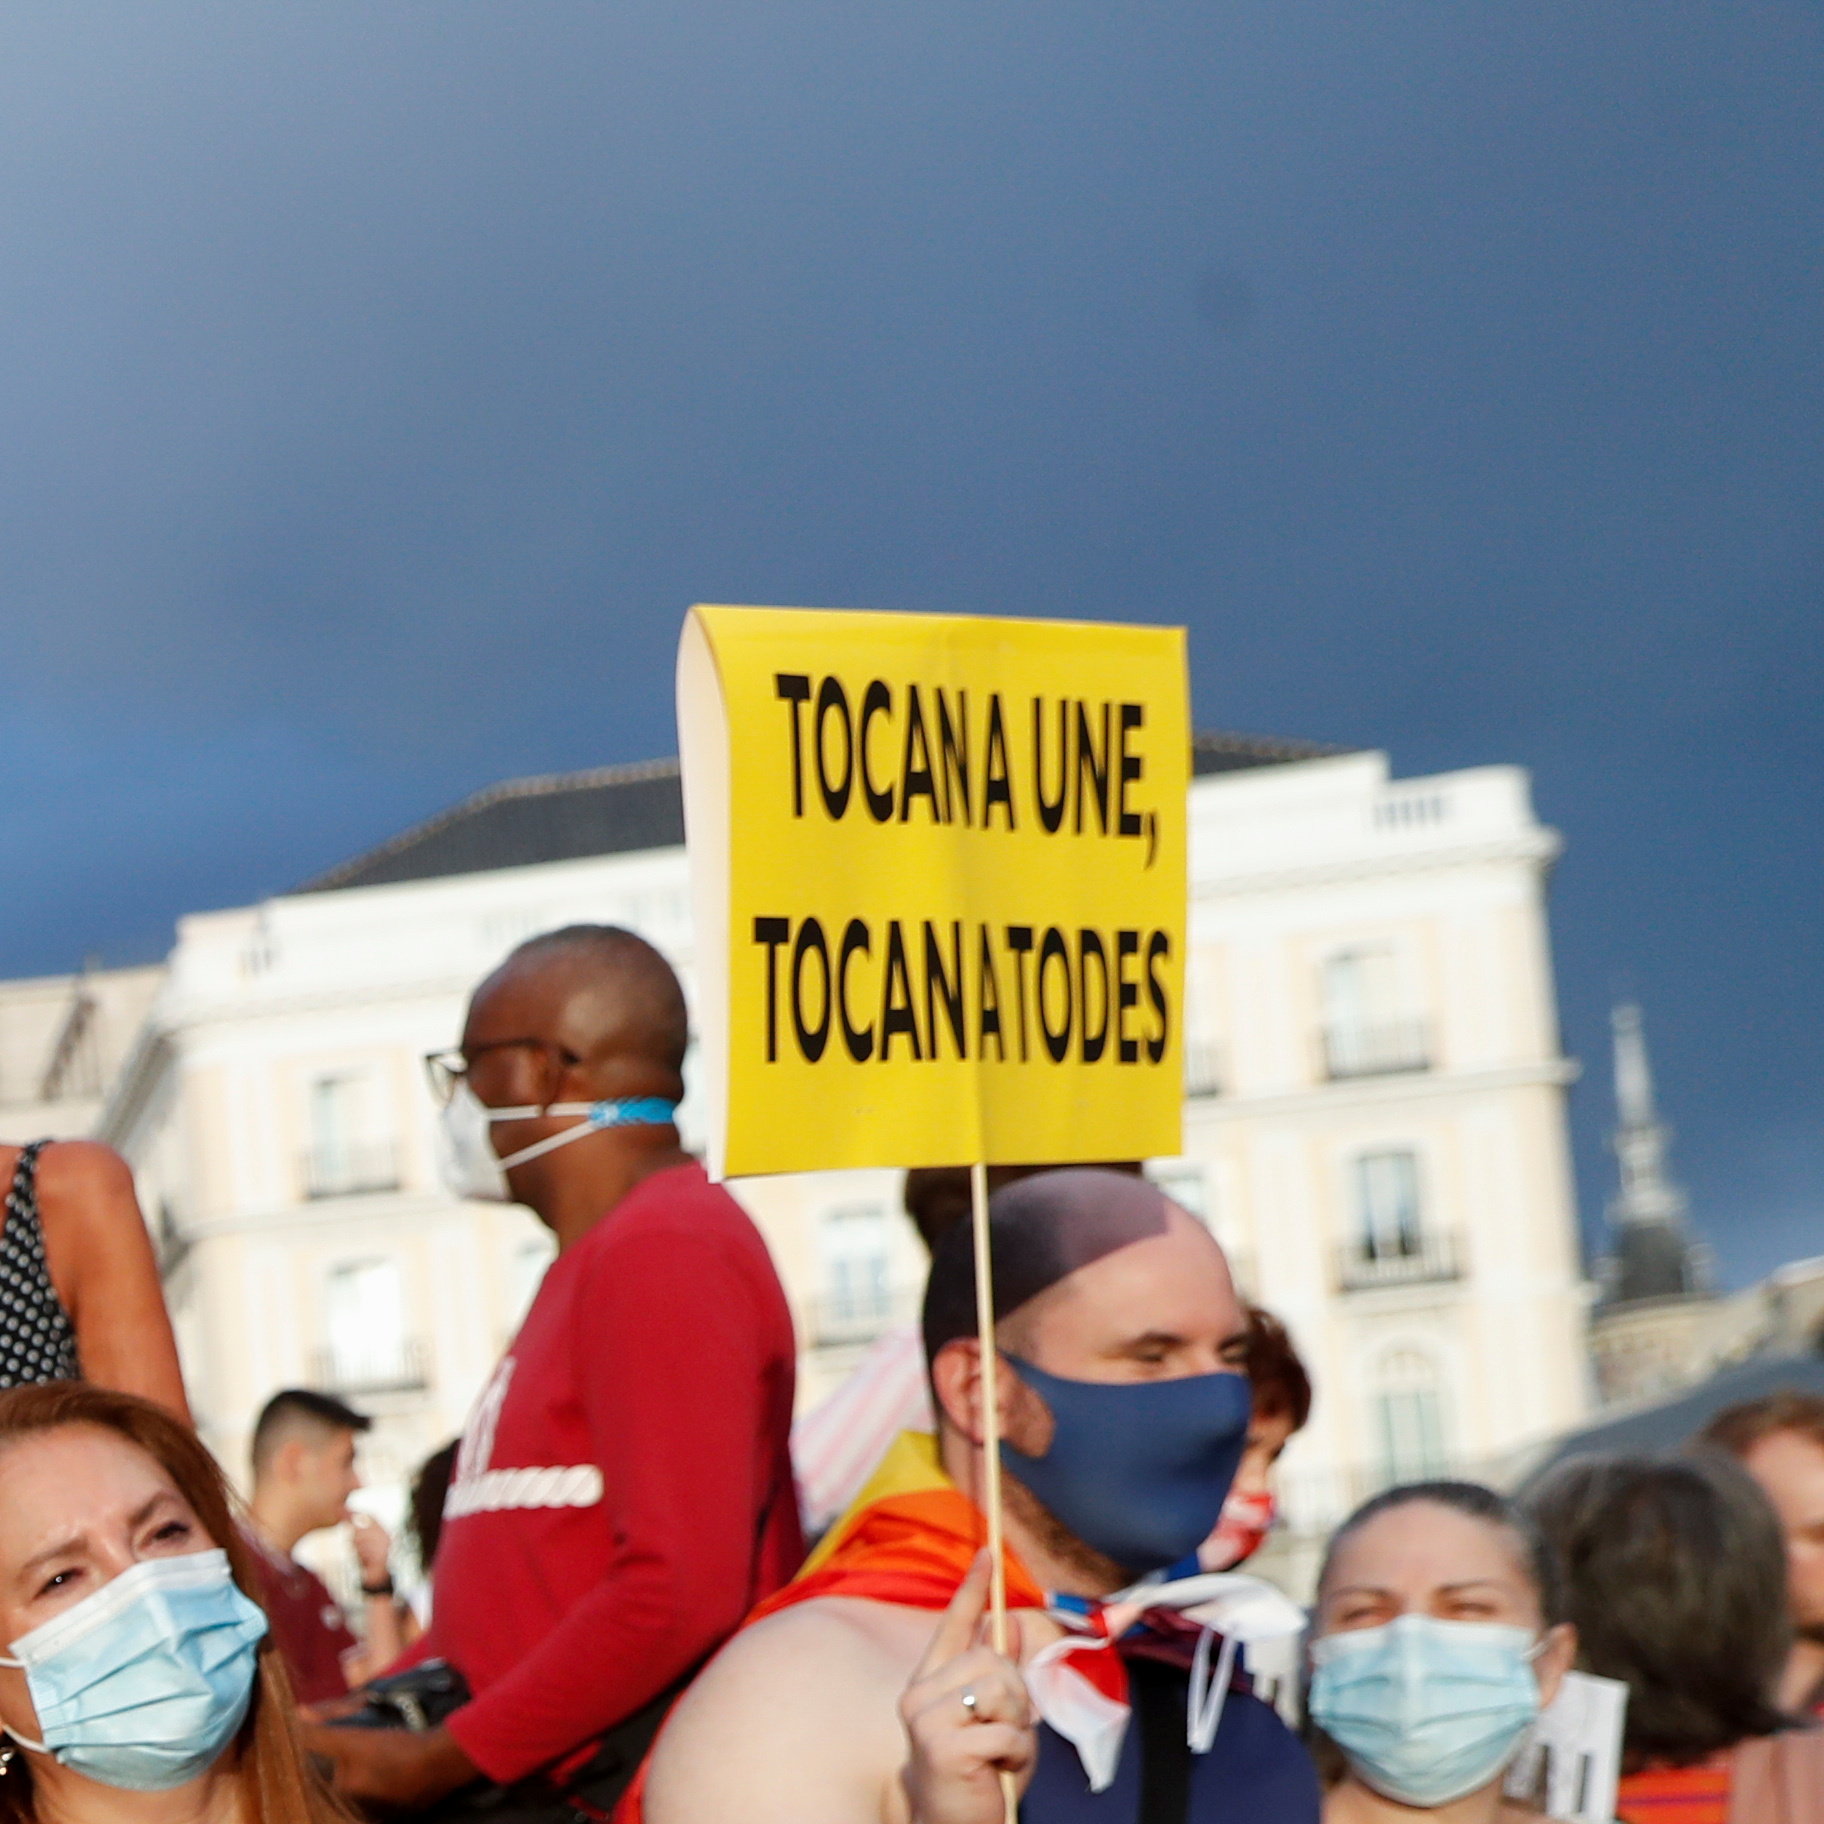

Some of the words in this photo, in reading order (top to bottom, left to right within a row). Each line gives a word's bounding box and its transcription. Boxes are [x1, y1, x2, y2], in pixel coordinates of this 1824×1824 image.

[773, 672, 973, 829] TOCAN
[982, 692, 1017, 832] A
[1032, 696, 1159, 868] UNE,
[753, 915, 967, 1064] TOCAN
[978, 922, 1005, 1063] A
[1006, 925, 1172, 1065] TODES
